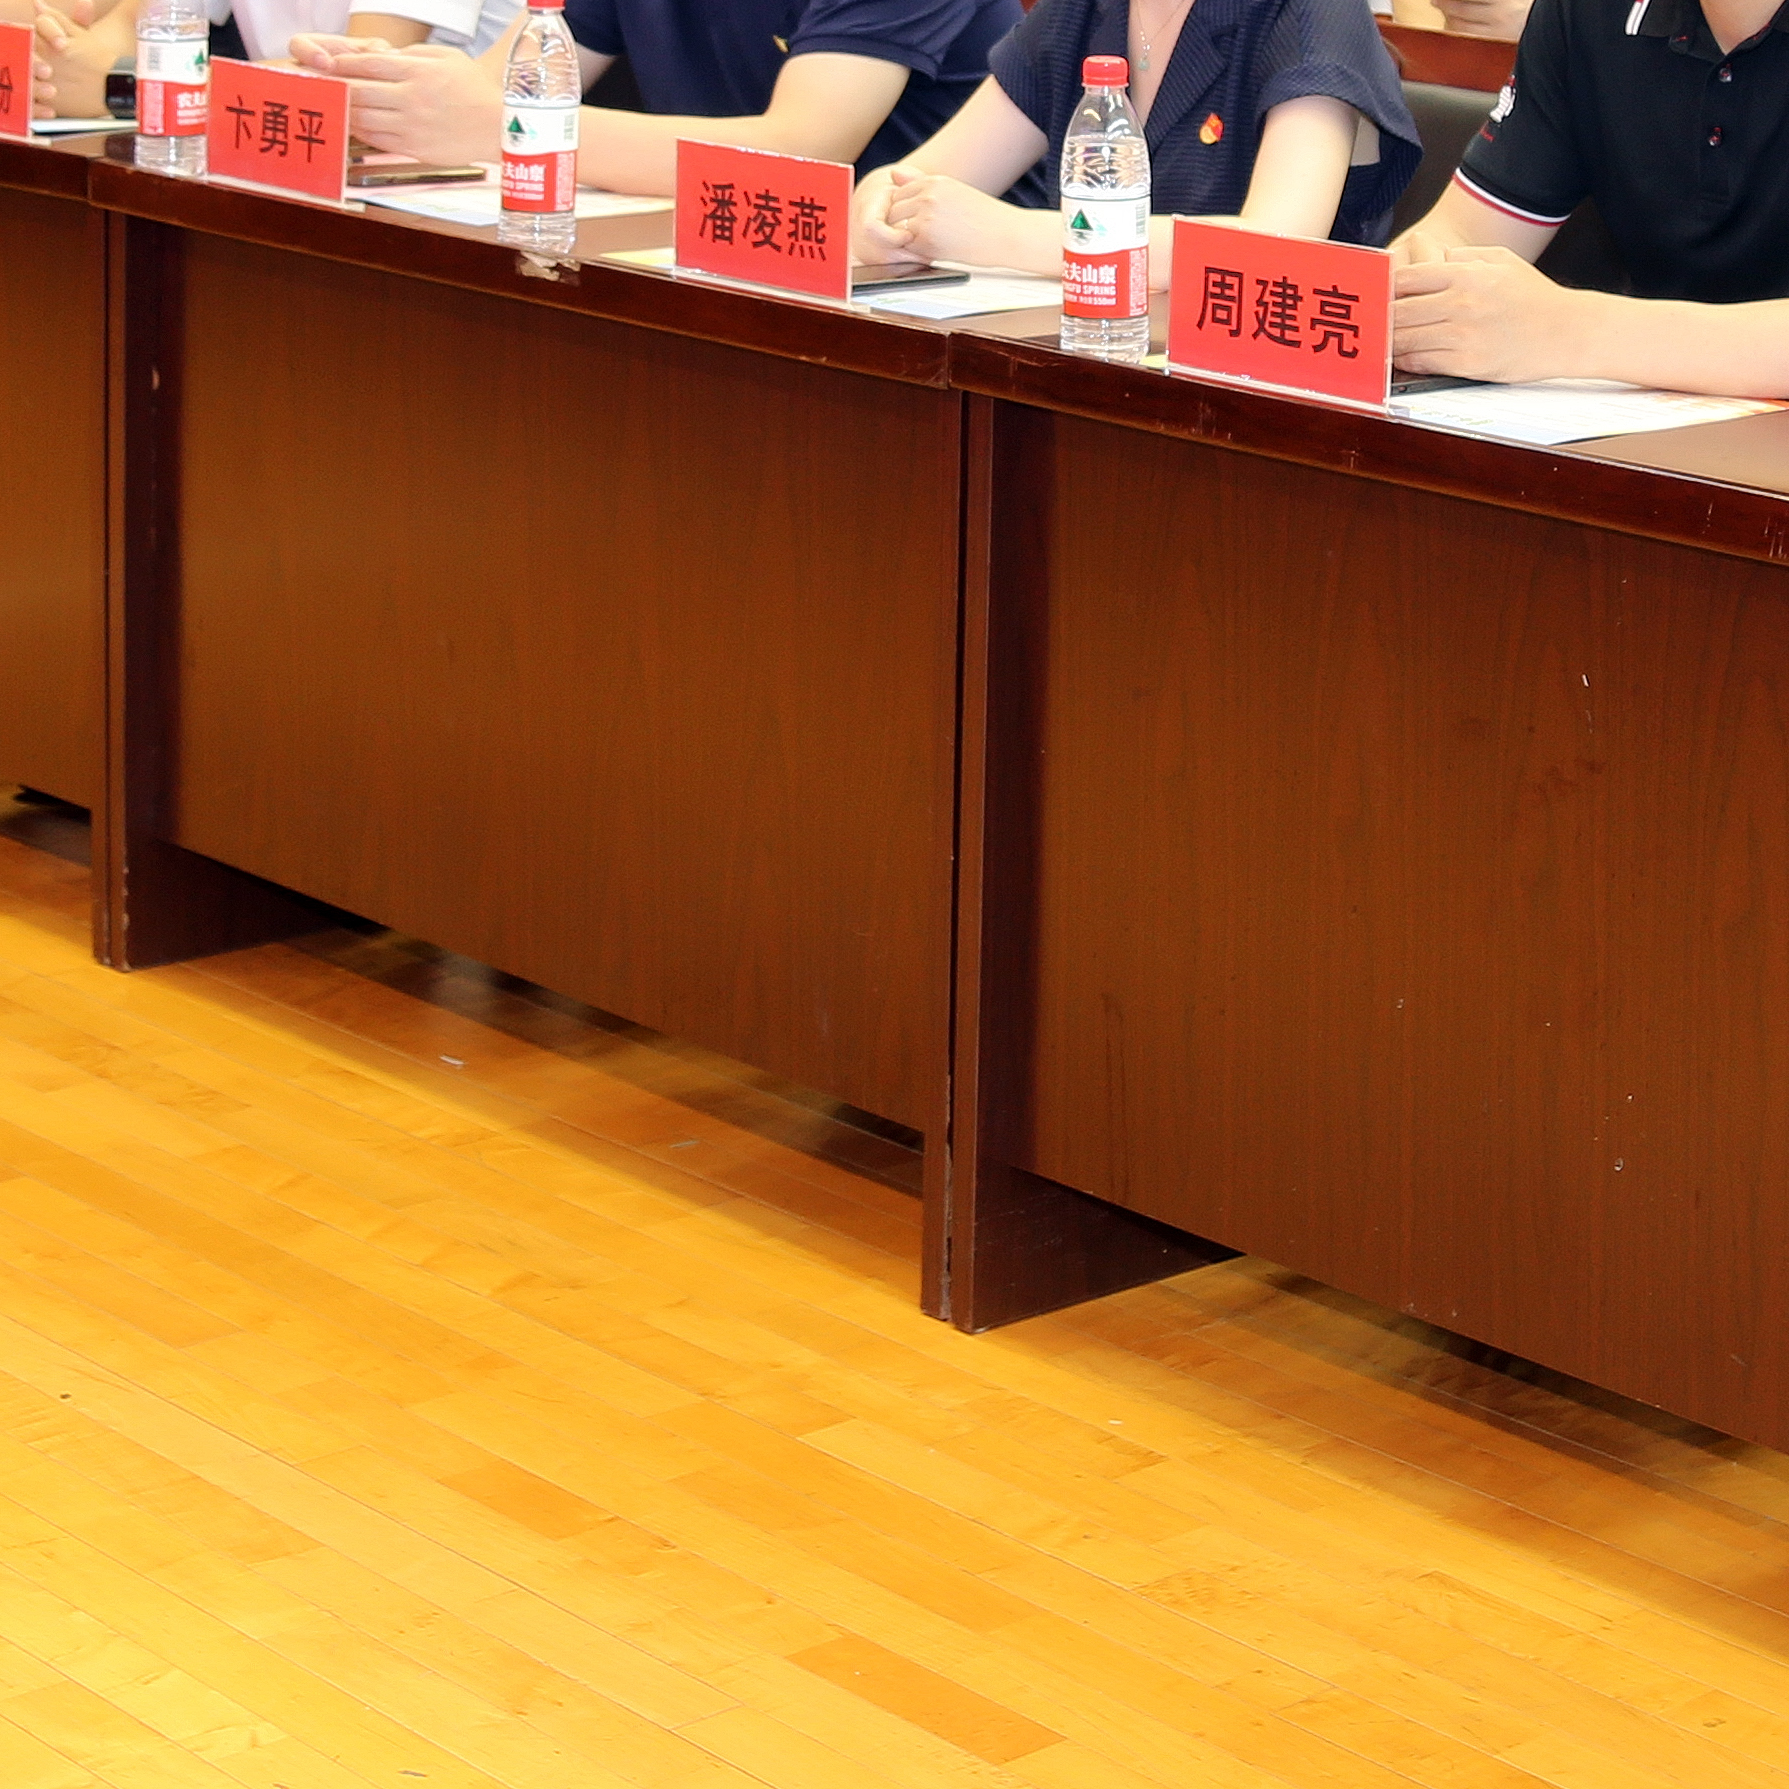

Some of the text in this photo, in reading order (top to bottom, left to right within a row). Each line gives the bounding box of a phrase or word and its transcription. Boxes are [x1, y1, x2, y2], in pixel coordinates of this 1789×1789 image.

[225, 94, 326, 163] 卞勇平
[698, 180, 827, 261] 潘凌燕
[1082, 286, 1116, 296] SPRING
[1196, 266, 1359, 359] 周建亮
